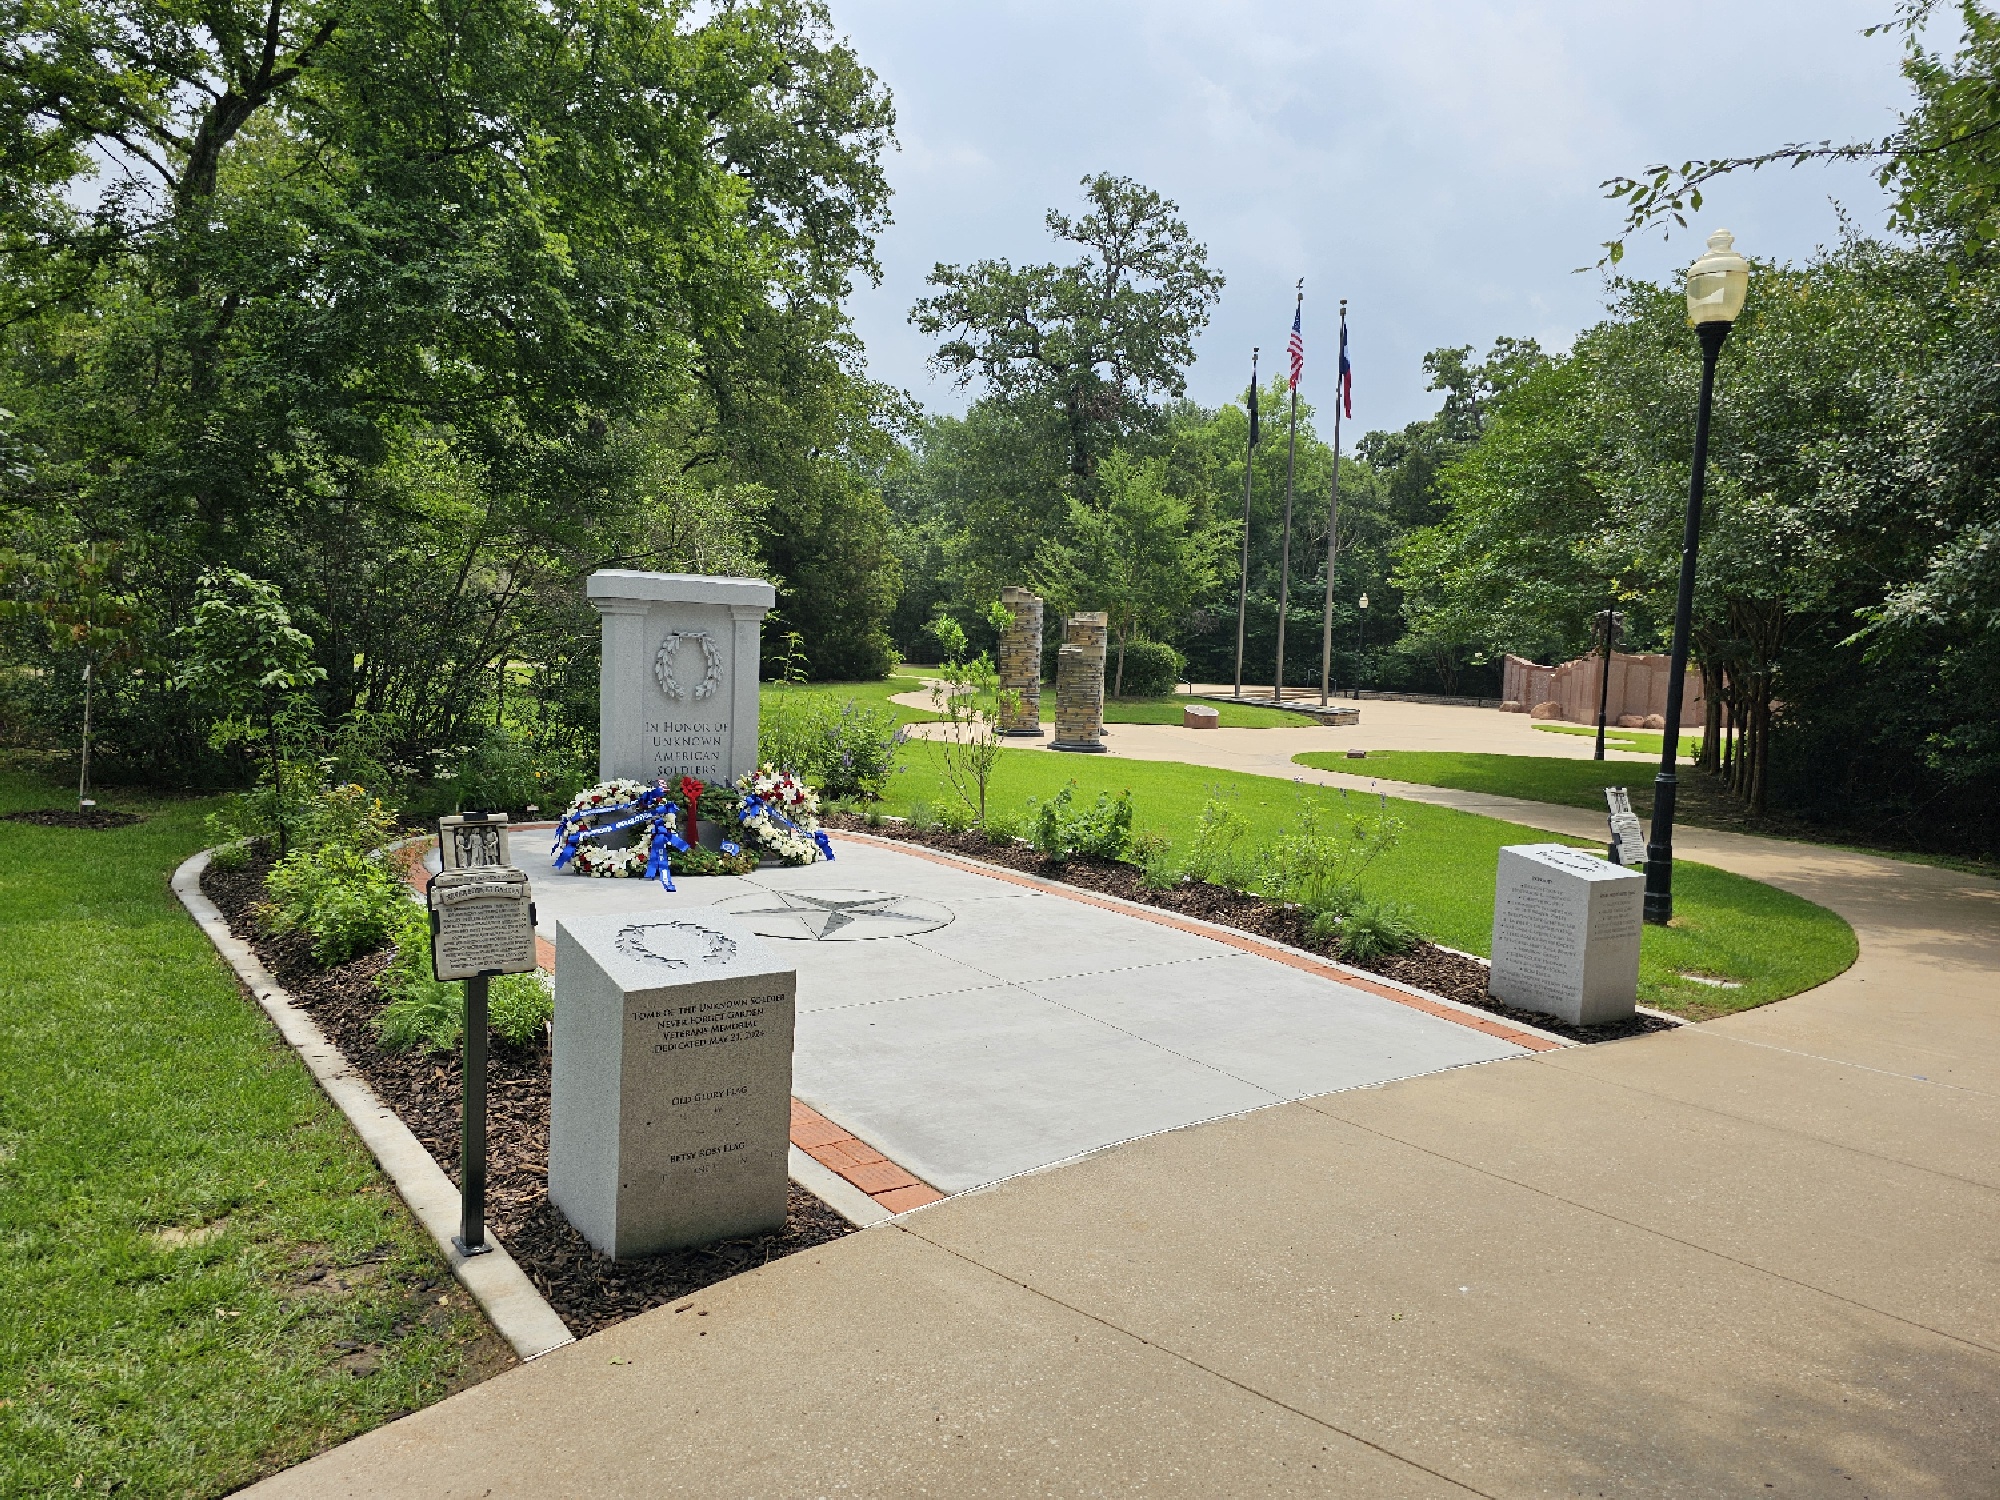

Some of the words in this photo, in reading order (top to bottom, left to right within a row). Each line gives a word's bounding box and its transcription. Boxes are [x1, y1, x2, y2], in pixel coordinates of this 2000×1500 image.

[646, 722, 659, 733] IN
[664, 722, 711, 733] HONOR
[715, 723, 729, 733] OF
[653, 736, 721, 746] UNKNOWN
[655, 751, 720, 761] AMERICAN
[658, 765, 716, 776] SOLDIERS
[632, 1012, 661, 1021] TOMB
[679, 1005, 697, 1015] THE
[700, 1000, 748, 1013] UNKNOWN
[751, 994, 785, 1006] SOLDIER
[658, 1019, 688, 1030] NEVER
[691, 1012, 724, 1025] FORGET
[727, 1008, 764, 1019] GARDEN
[663, 1027, 708, 1040] VETERANS
[711, 1020, 758, 1034] MEMORIAL
[653, 1039, 707, 1053] DEDICATED
[709, 1036, 729, 1046] MAY
[672, 1096, 692, 1105] OLD
[694, 1090, 724, 1102] GLORY
[727, 1085, 748, 1096] FLAG
[670, 1152, 696, 1162] BETSY
[723, 1141, 745, 1153] FLAG
